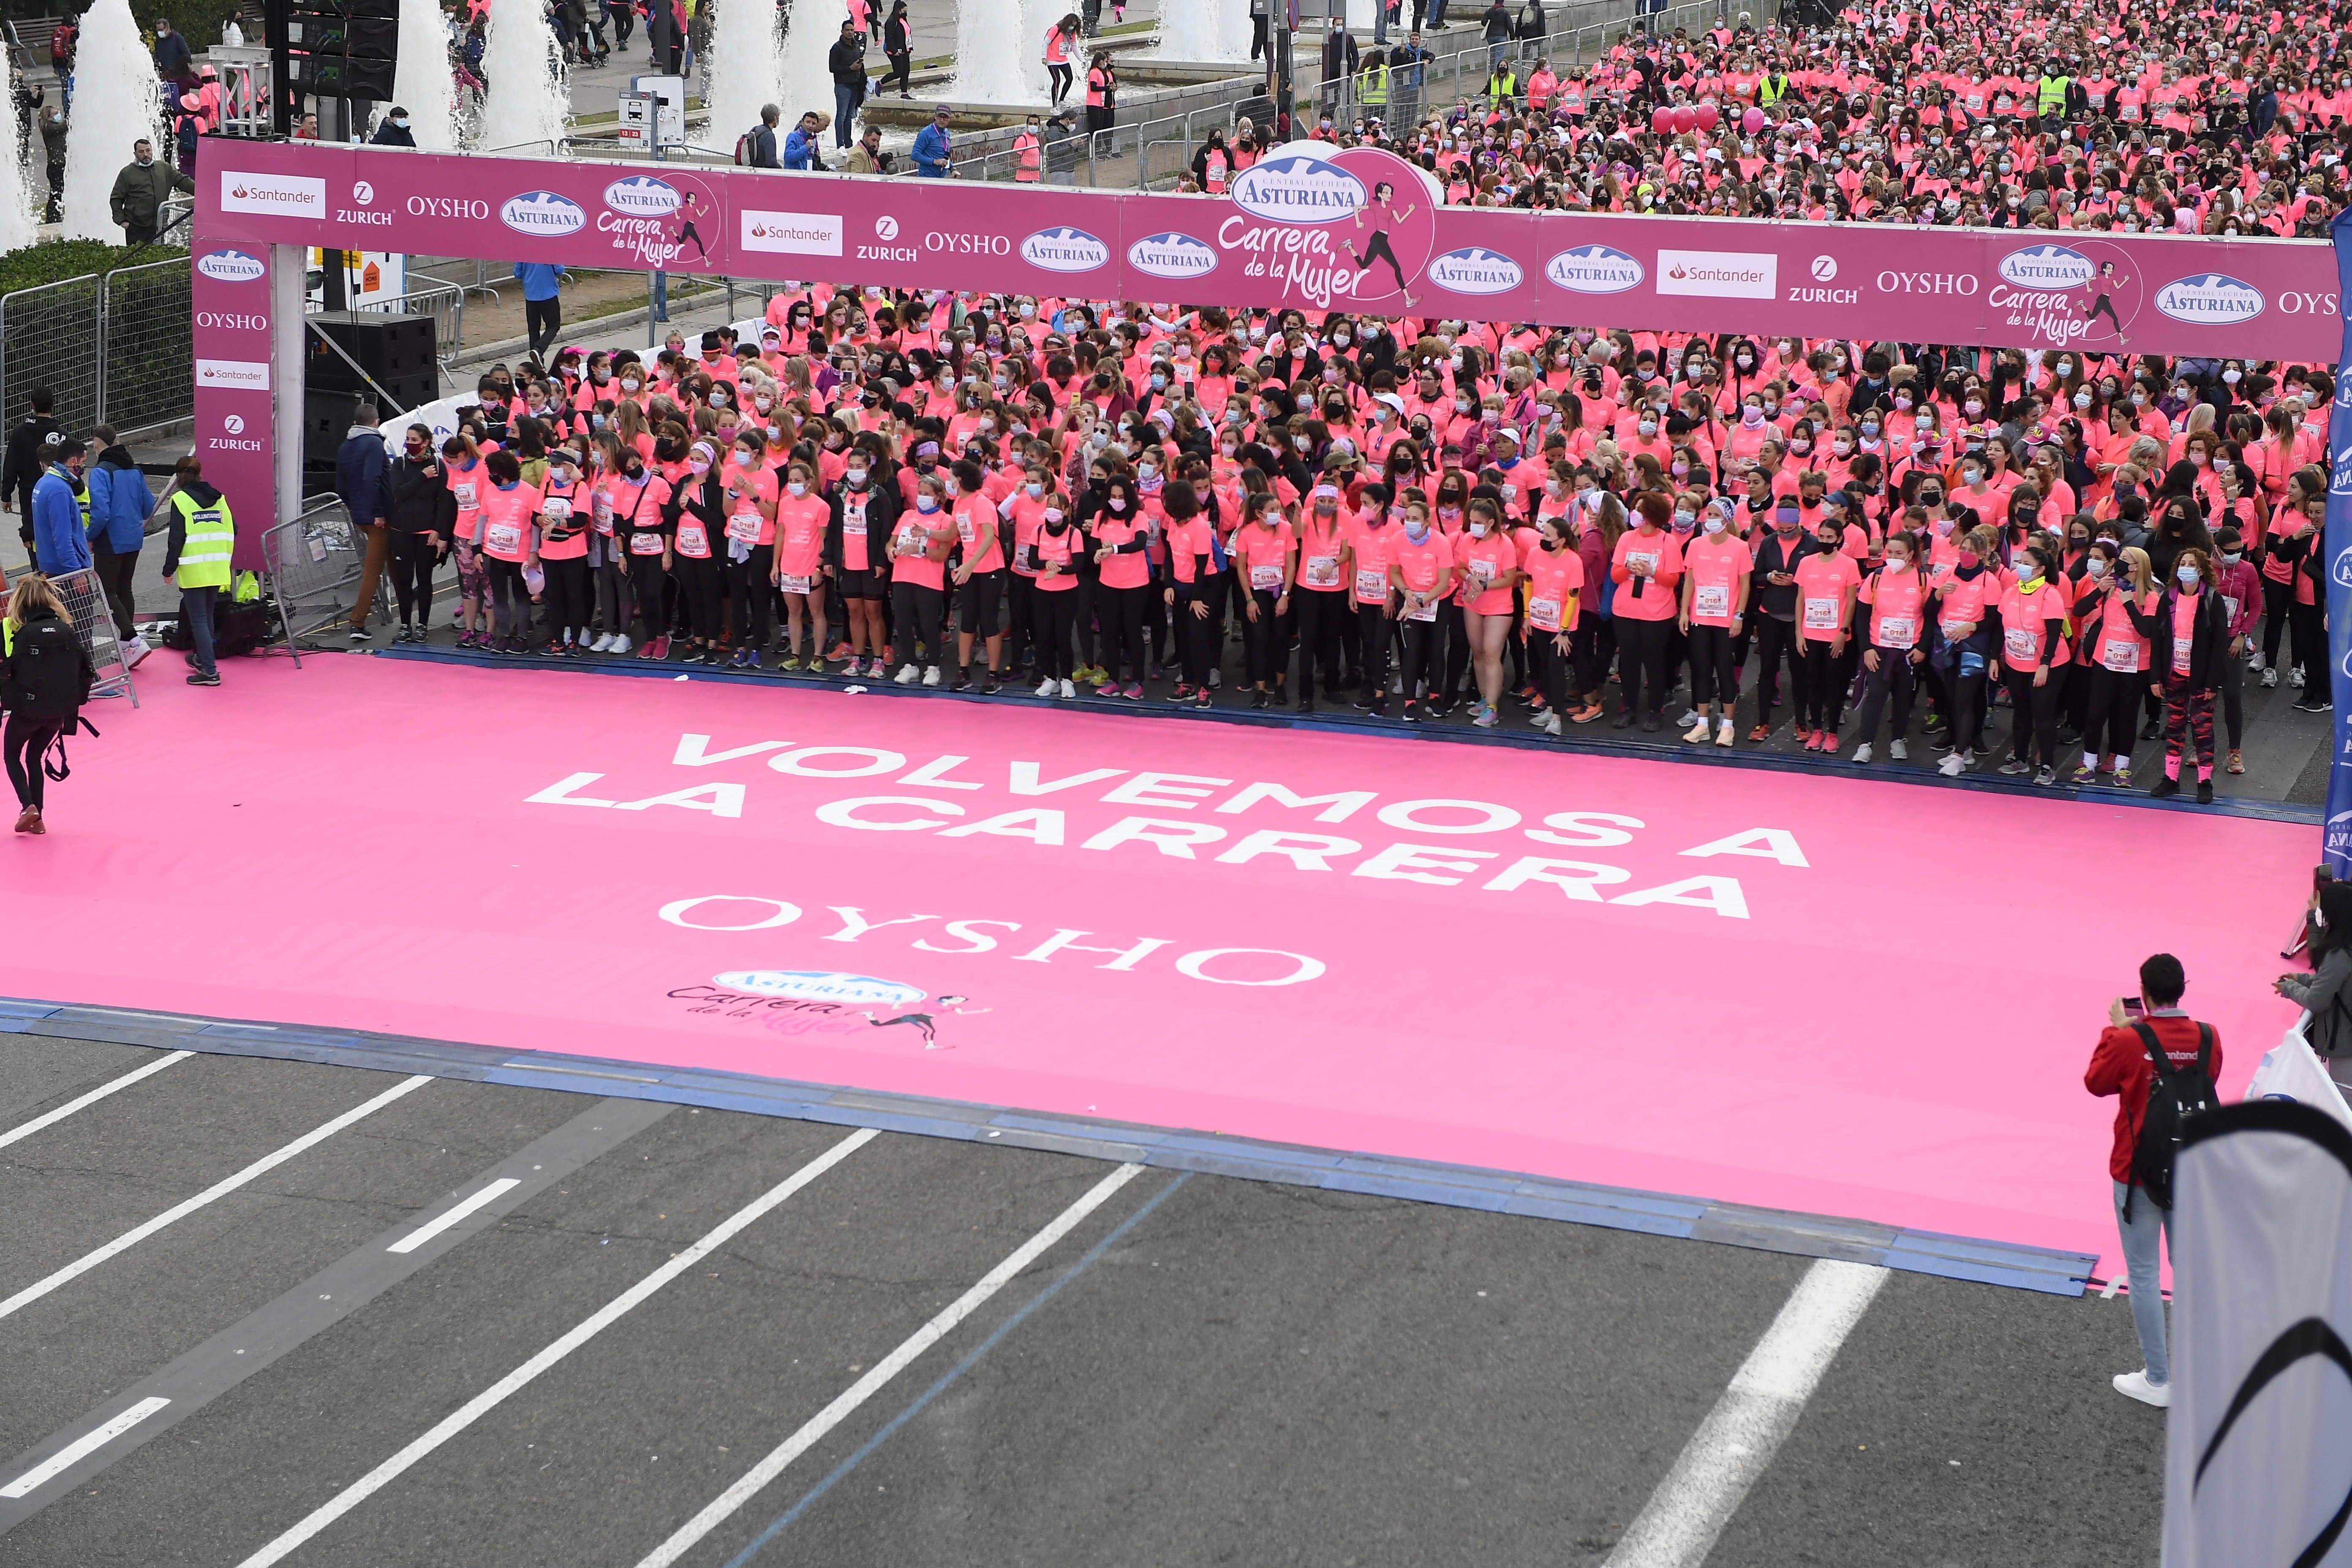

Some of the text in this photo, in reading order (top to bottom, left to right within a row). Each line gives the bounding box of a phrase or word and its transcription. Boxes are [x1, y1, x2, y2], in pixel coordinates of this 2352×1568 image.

[1242, 179, 1355, 207] ASTURIANA
[1263, 178, 1353, 189] CENTRAL LECHERA
[250, 187, 316, 204] Santander
[611, 188, 675, 208] ASTURIANA
[337, 209, 392, 226] ZURICH
[406, 196, 489, 220] OYSHO
[506, 205, 579, 227] ASTURIANA
[597, 211, 662, 235] Carrera
[769, 226, 832, 241] Santander
[925, 231, 1010, 255] OYSHO
[1218, 215, 1329, 254] Carrera
[612, 234, 685, 268] de la Mujer
[857, 245, 917, 262] ZURICH
[1027, 241, 1101, 261] ASTURIANA
[1135, 250, 1210, 268] ASTURIANA
[202, 260, 260, 275] ASTURIANA
[1435, 262, 1514, 283] ASTURIANA
[1553, 261, 1635, 282] ASTURIANA
[1689, 267, 1764, 283] Santander
[2006, 259, 2087, 279] ASTURIANA
[1244, 252, 1371, 309] de la Mujer
[1877, 271, 1979, 295] OYSHO
[1788, 287, 1857, 304] ZURICH
[1989, 284, 2067, 310] Carrera
[2163, 291, 2256, 313] ASTURIANA
[2279, 291, 2337, 316] OYS
[196, 312, 267, 330] OYSHO
[2006, 308, 2097, 346] de la Mujer
[216, 370, 262, 381] Santander
[209, 438, 261, 451] ZURICH
[672, 733, 1810, 868] VOLVEMOS A
[522, 772, 1751, 919] LA CARRERA
[658, 894, 1326, 986] OYSHO
[732, 974, 903, 1002] ASTURIANA
[667, 985, 842, 1014] Carrera
[687, 1004, 720, 1014] de
[725, 1004, 752, 1018] la
